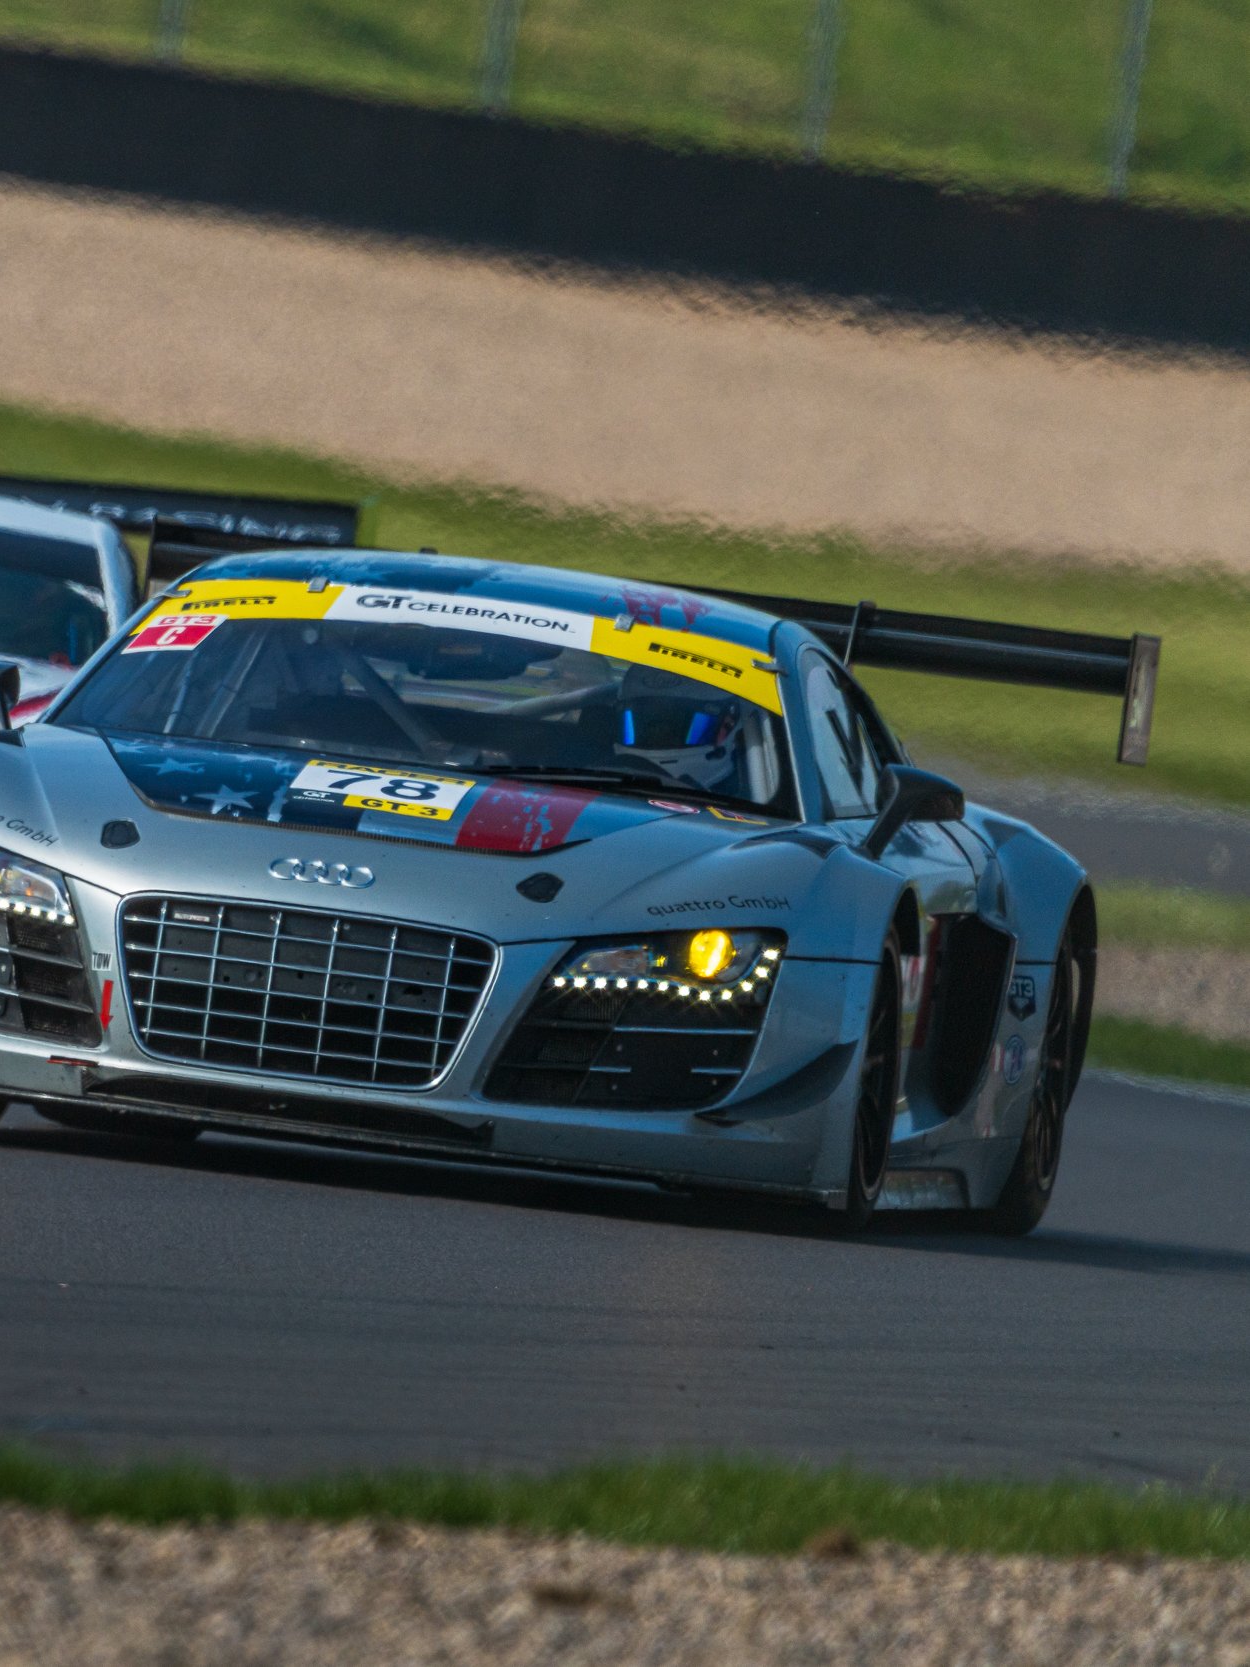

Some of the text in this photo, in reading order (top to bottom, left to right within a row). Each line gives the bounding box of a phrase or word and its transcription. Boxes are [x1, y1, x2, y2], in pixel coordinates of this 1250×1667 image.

[181, 596, 277, 611] PIRELLI
[356, 594, 570, 632] GT CELEBRATION
[158, 615, 216, 626] GT3
[156, 626, 186, 645] C
[648, 642, 744, 679] PIRELLI
[328, 769, 440, 801] 78
[6, 818, 59, 847] GmbH
[647, 896, 791, 917] quattro GmbH
[92, 952, 111, 970] TOW
